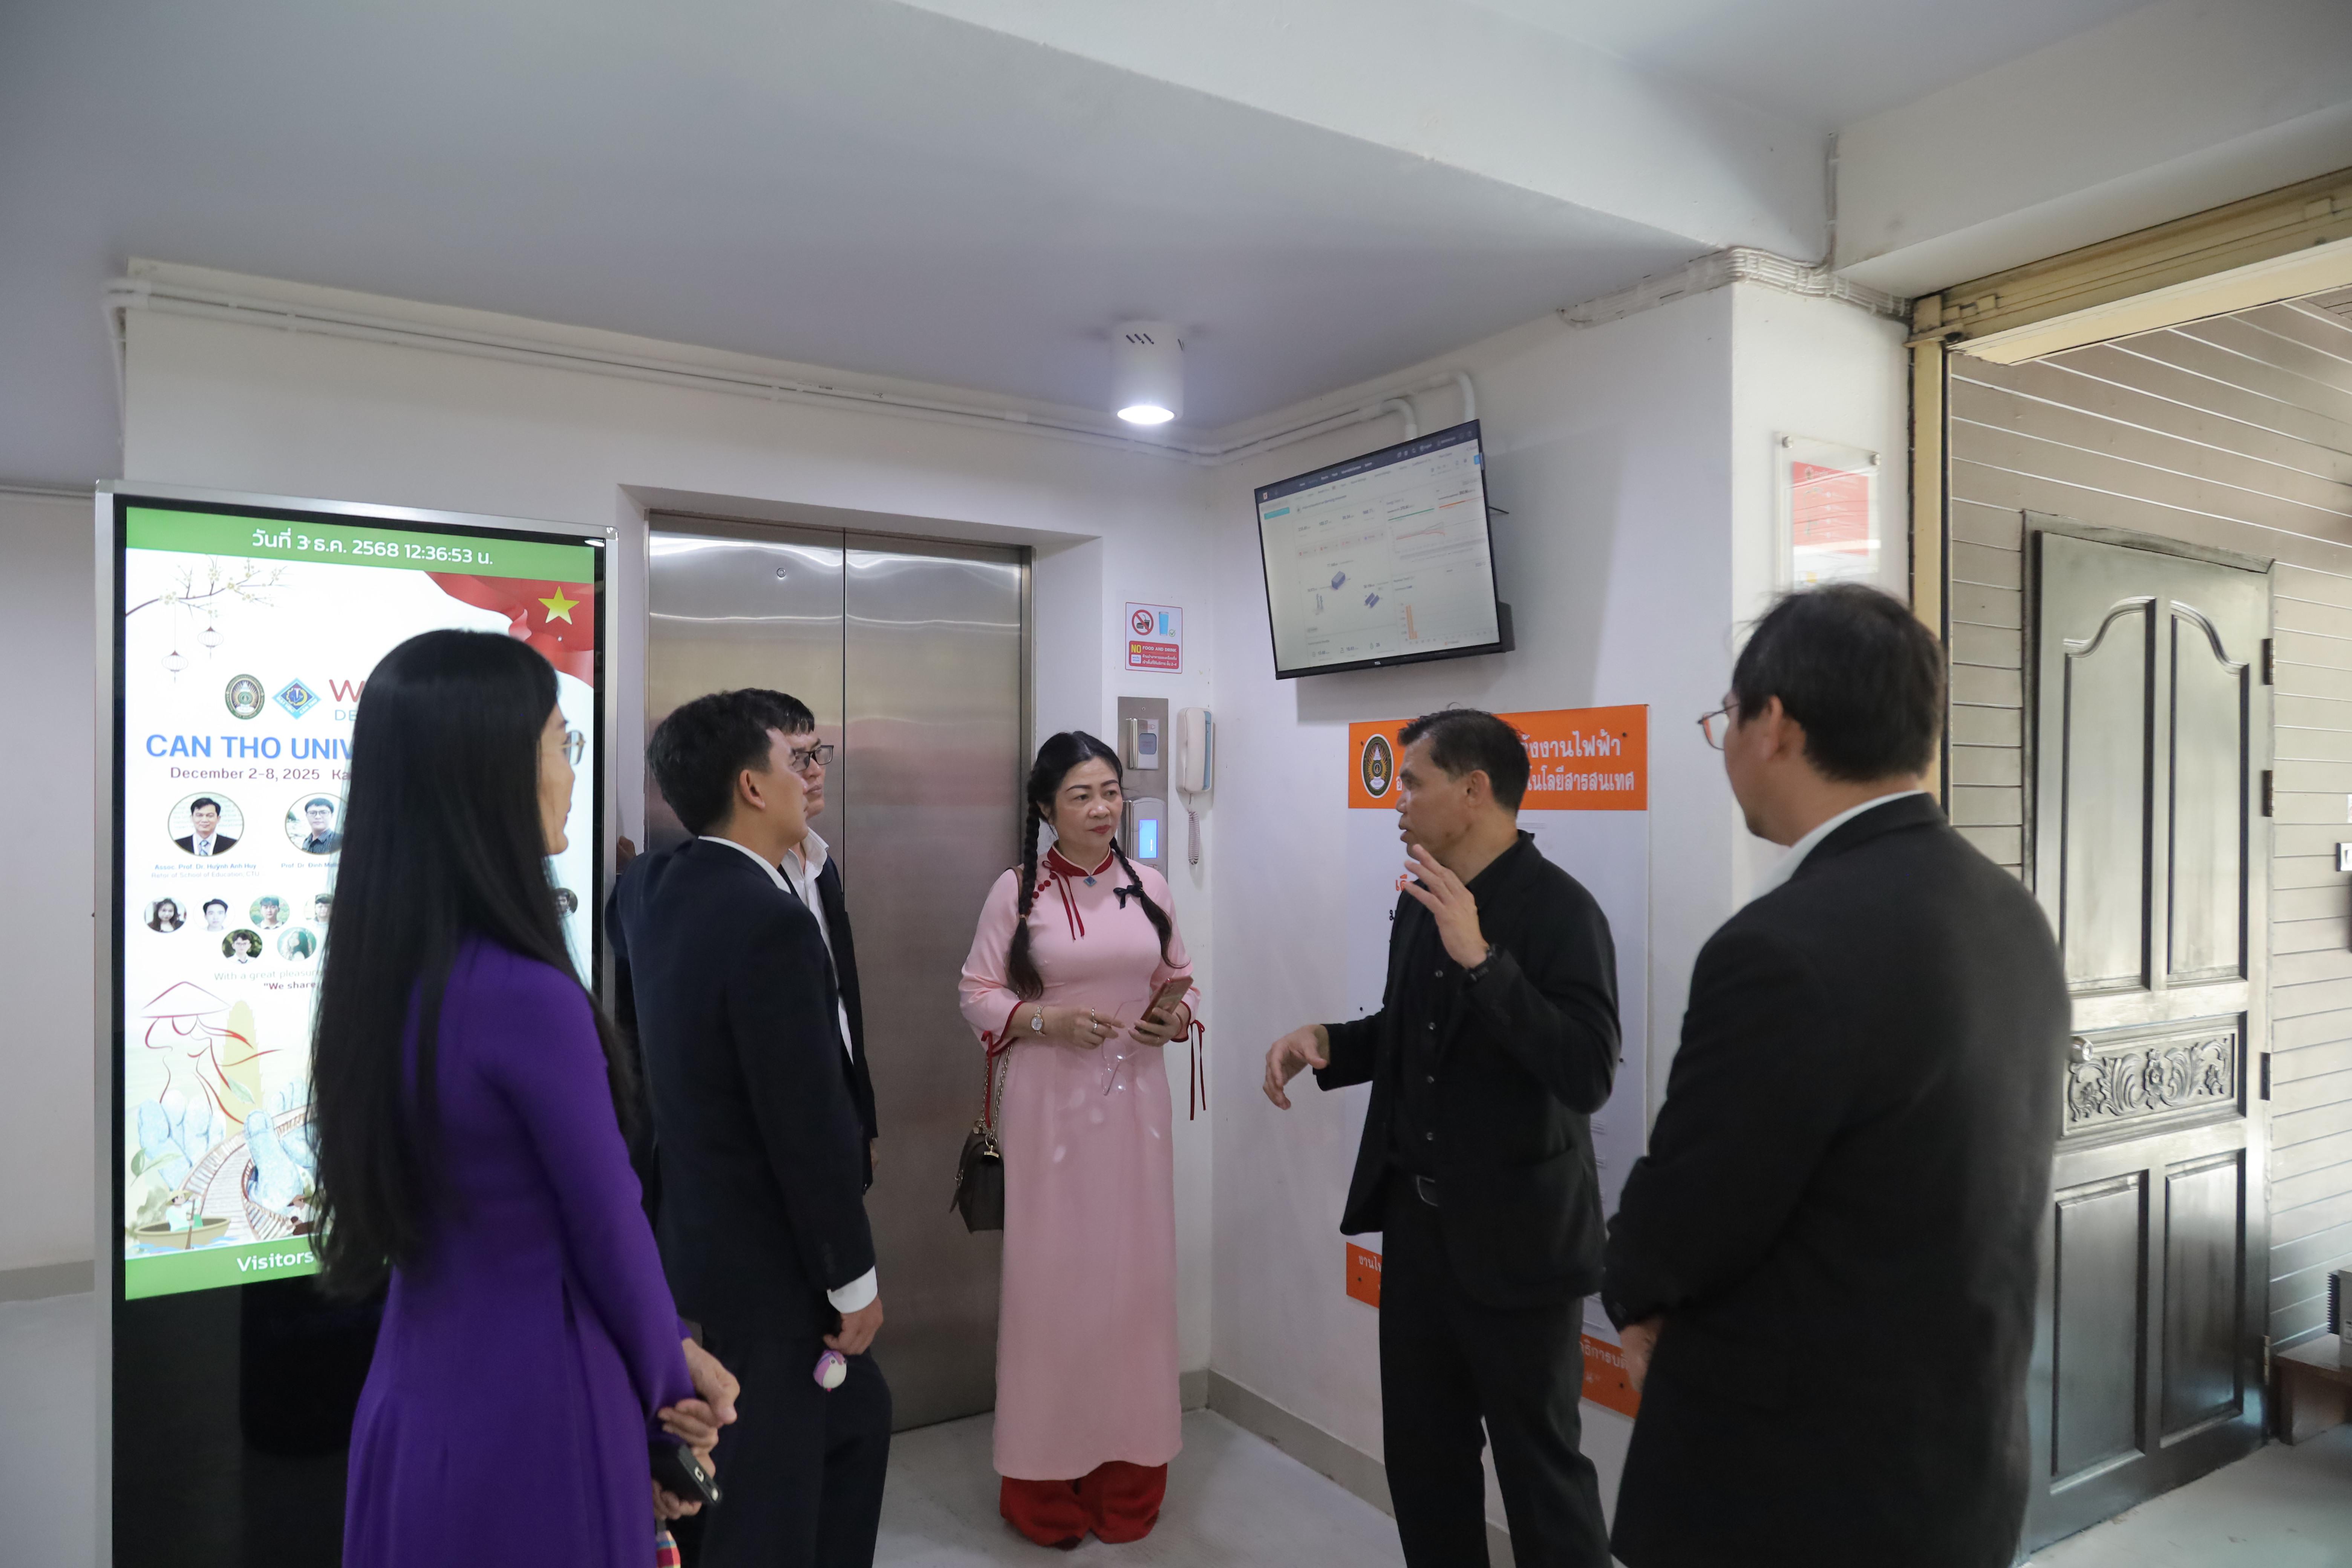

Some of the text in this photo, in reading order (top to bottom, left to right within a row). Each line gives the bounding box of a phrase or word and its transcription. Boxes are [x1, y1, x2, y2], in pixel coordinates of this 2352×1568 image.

[252, 528, 493, 565] วันที่ 3 ธ.ค. 2568 12:36:53 น.
[1131, 644, 1142, 653] NO
[146, 734, 211, 758] CAN
[221, 736, 280, 759] THO
[171, 767, 243, 779] December
[249, 768, 278, 782] 2-8,
[283, 768, 320, 779] 2025
[214, 972, 237, 980] With
[250, 971, 276, 981] great
[237, 1251, 314, 1272] Visitors
